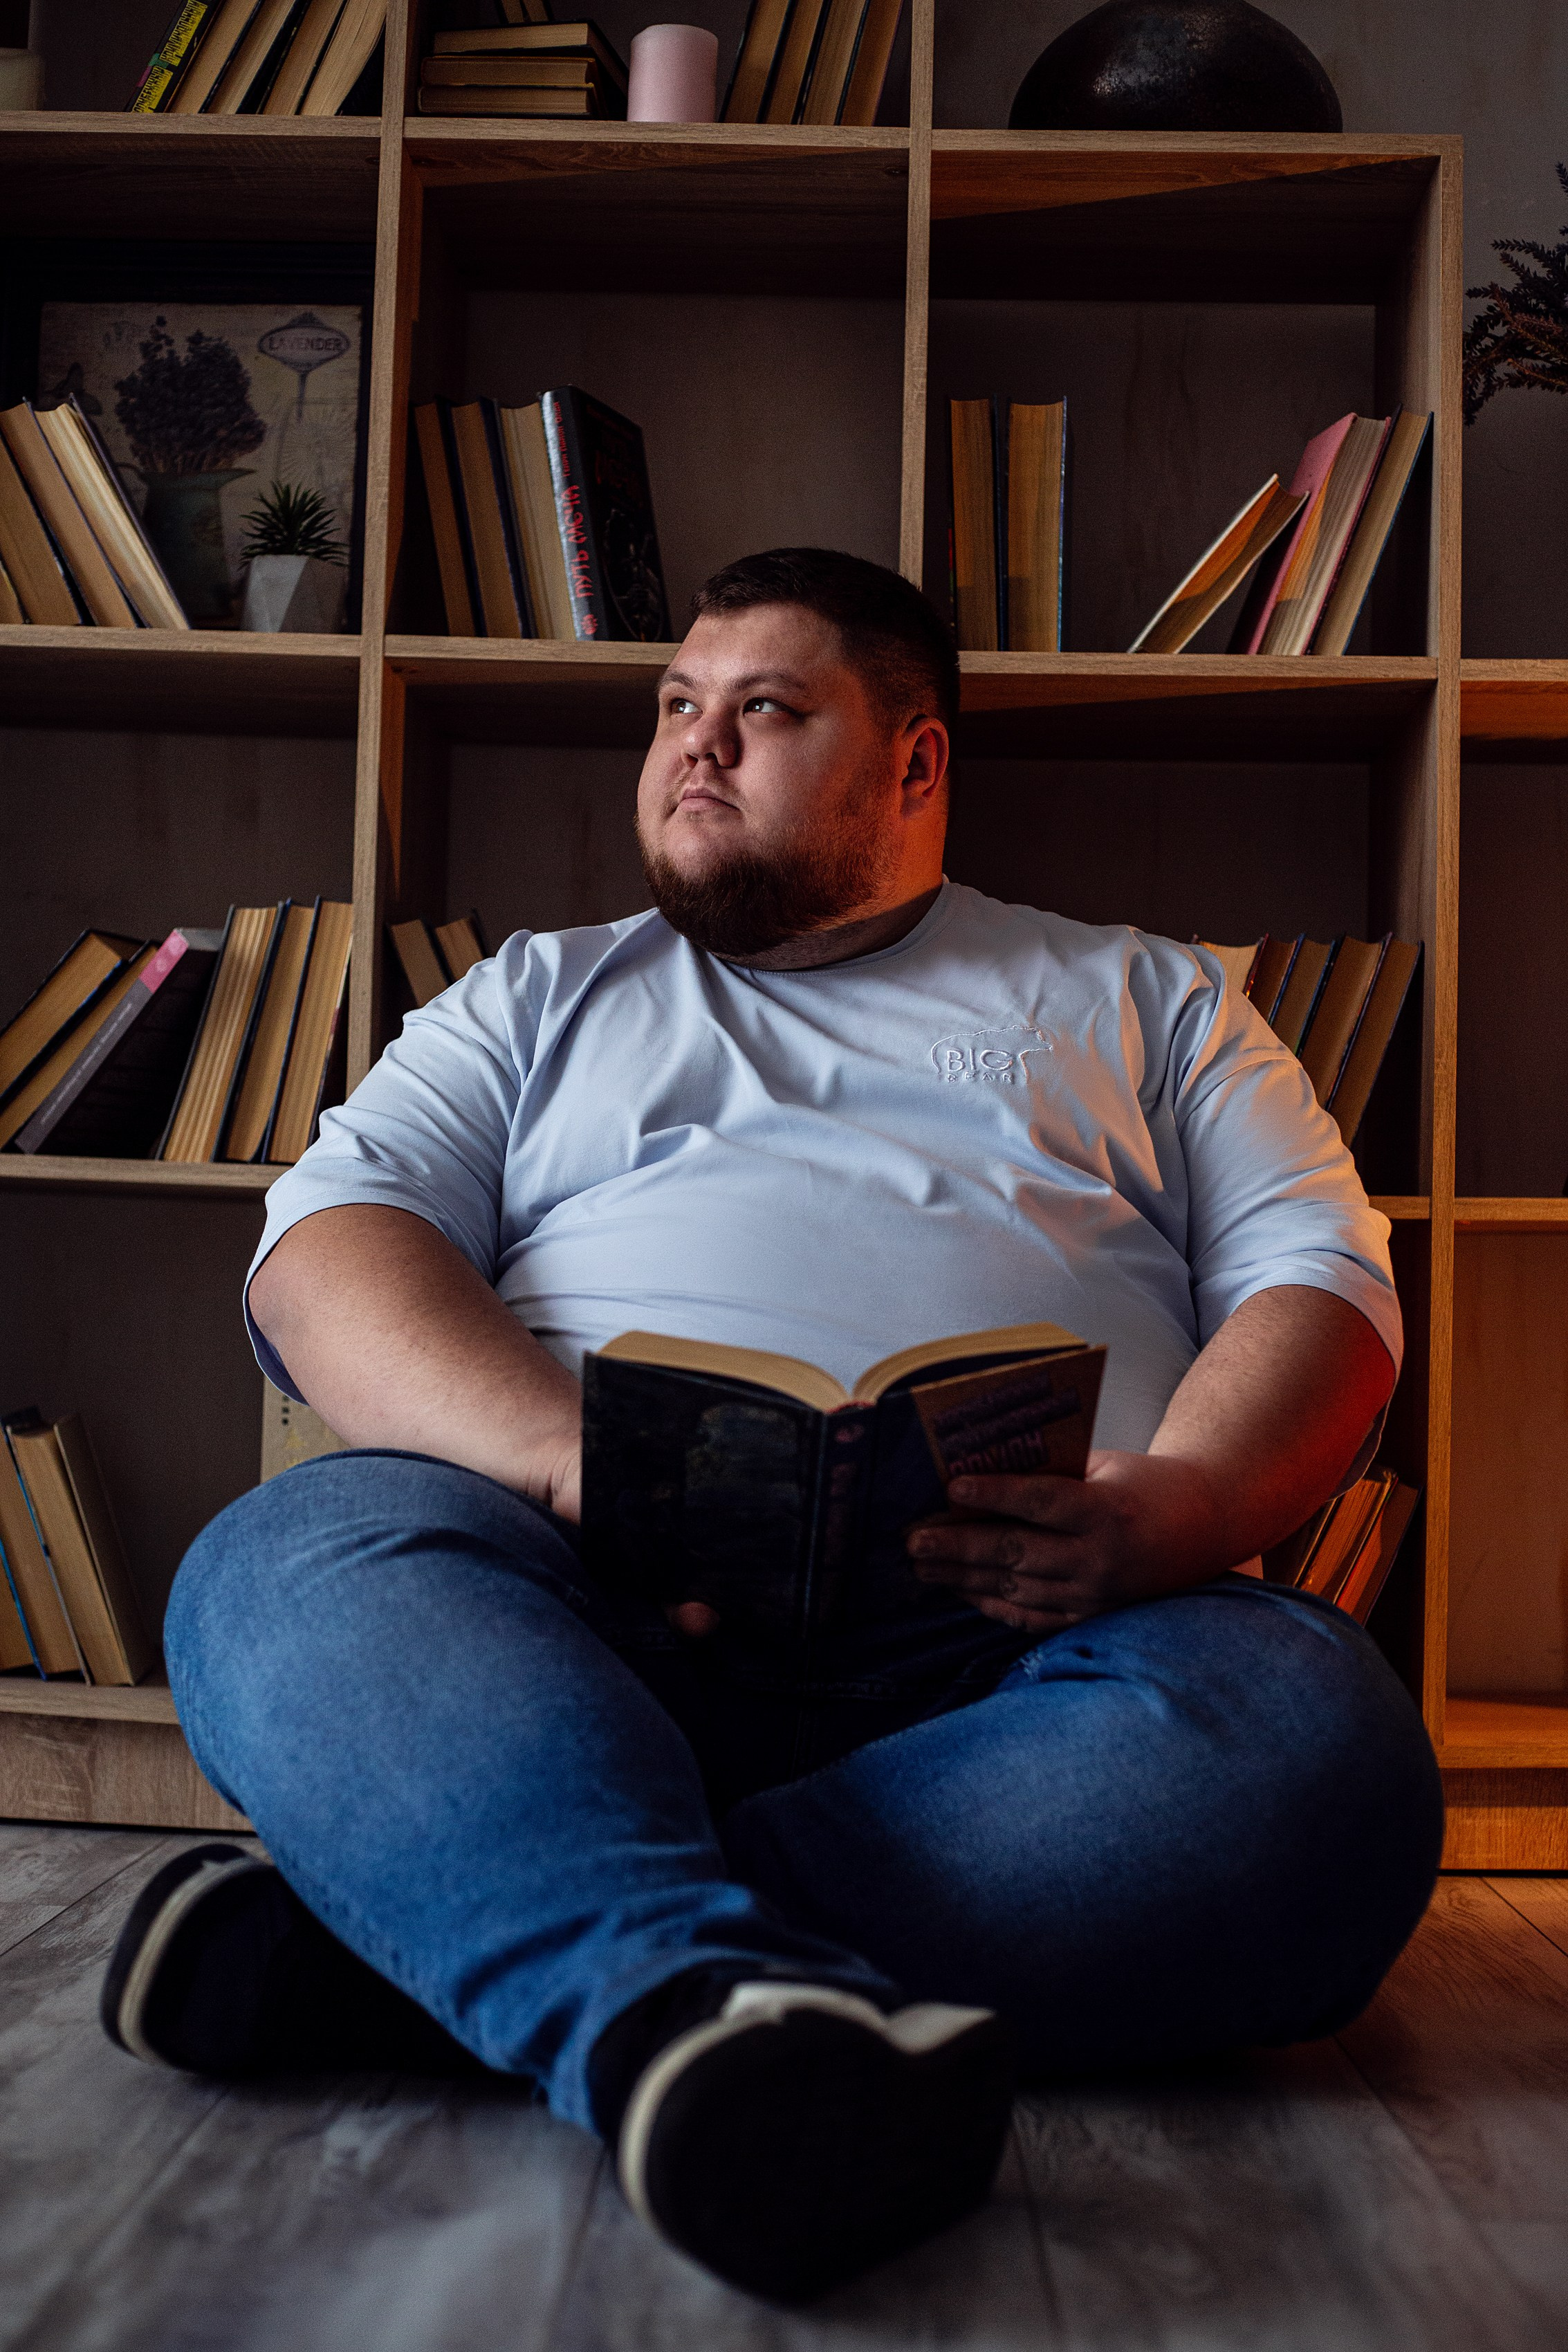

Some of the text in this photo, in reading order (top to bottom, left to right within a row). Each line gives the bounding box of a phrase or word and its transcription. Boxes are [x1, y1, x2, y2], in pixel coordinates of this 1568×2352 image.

[268, 337, 342, 351] LAVENDER
[561, 485, 594, 598] ПУТЬ МЕЧА
[946, 1048, 1013, 1072] BIG
[946, 1072, 1015, 1084] BEAR
